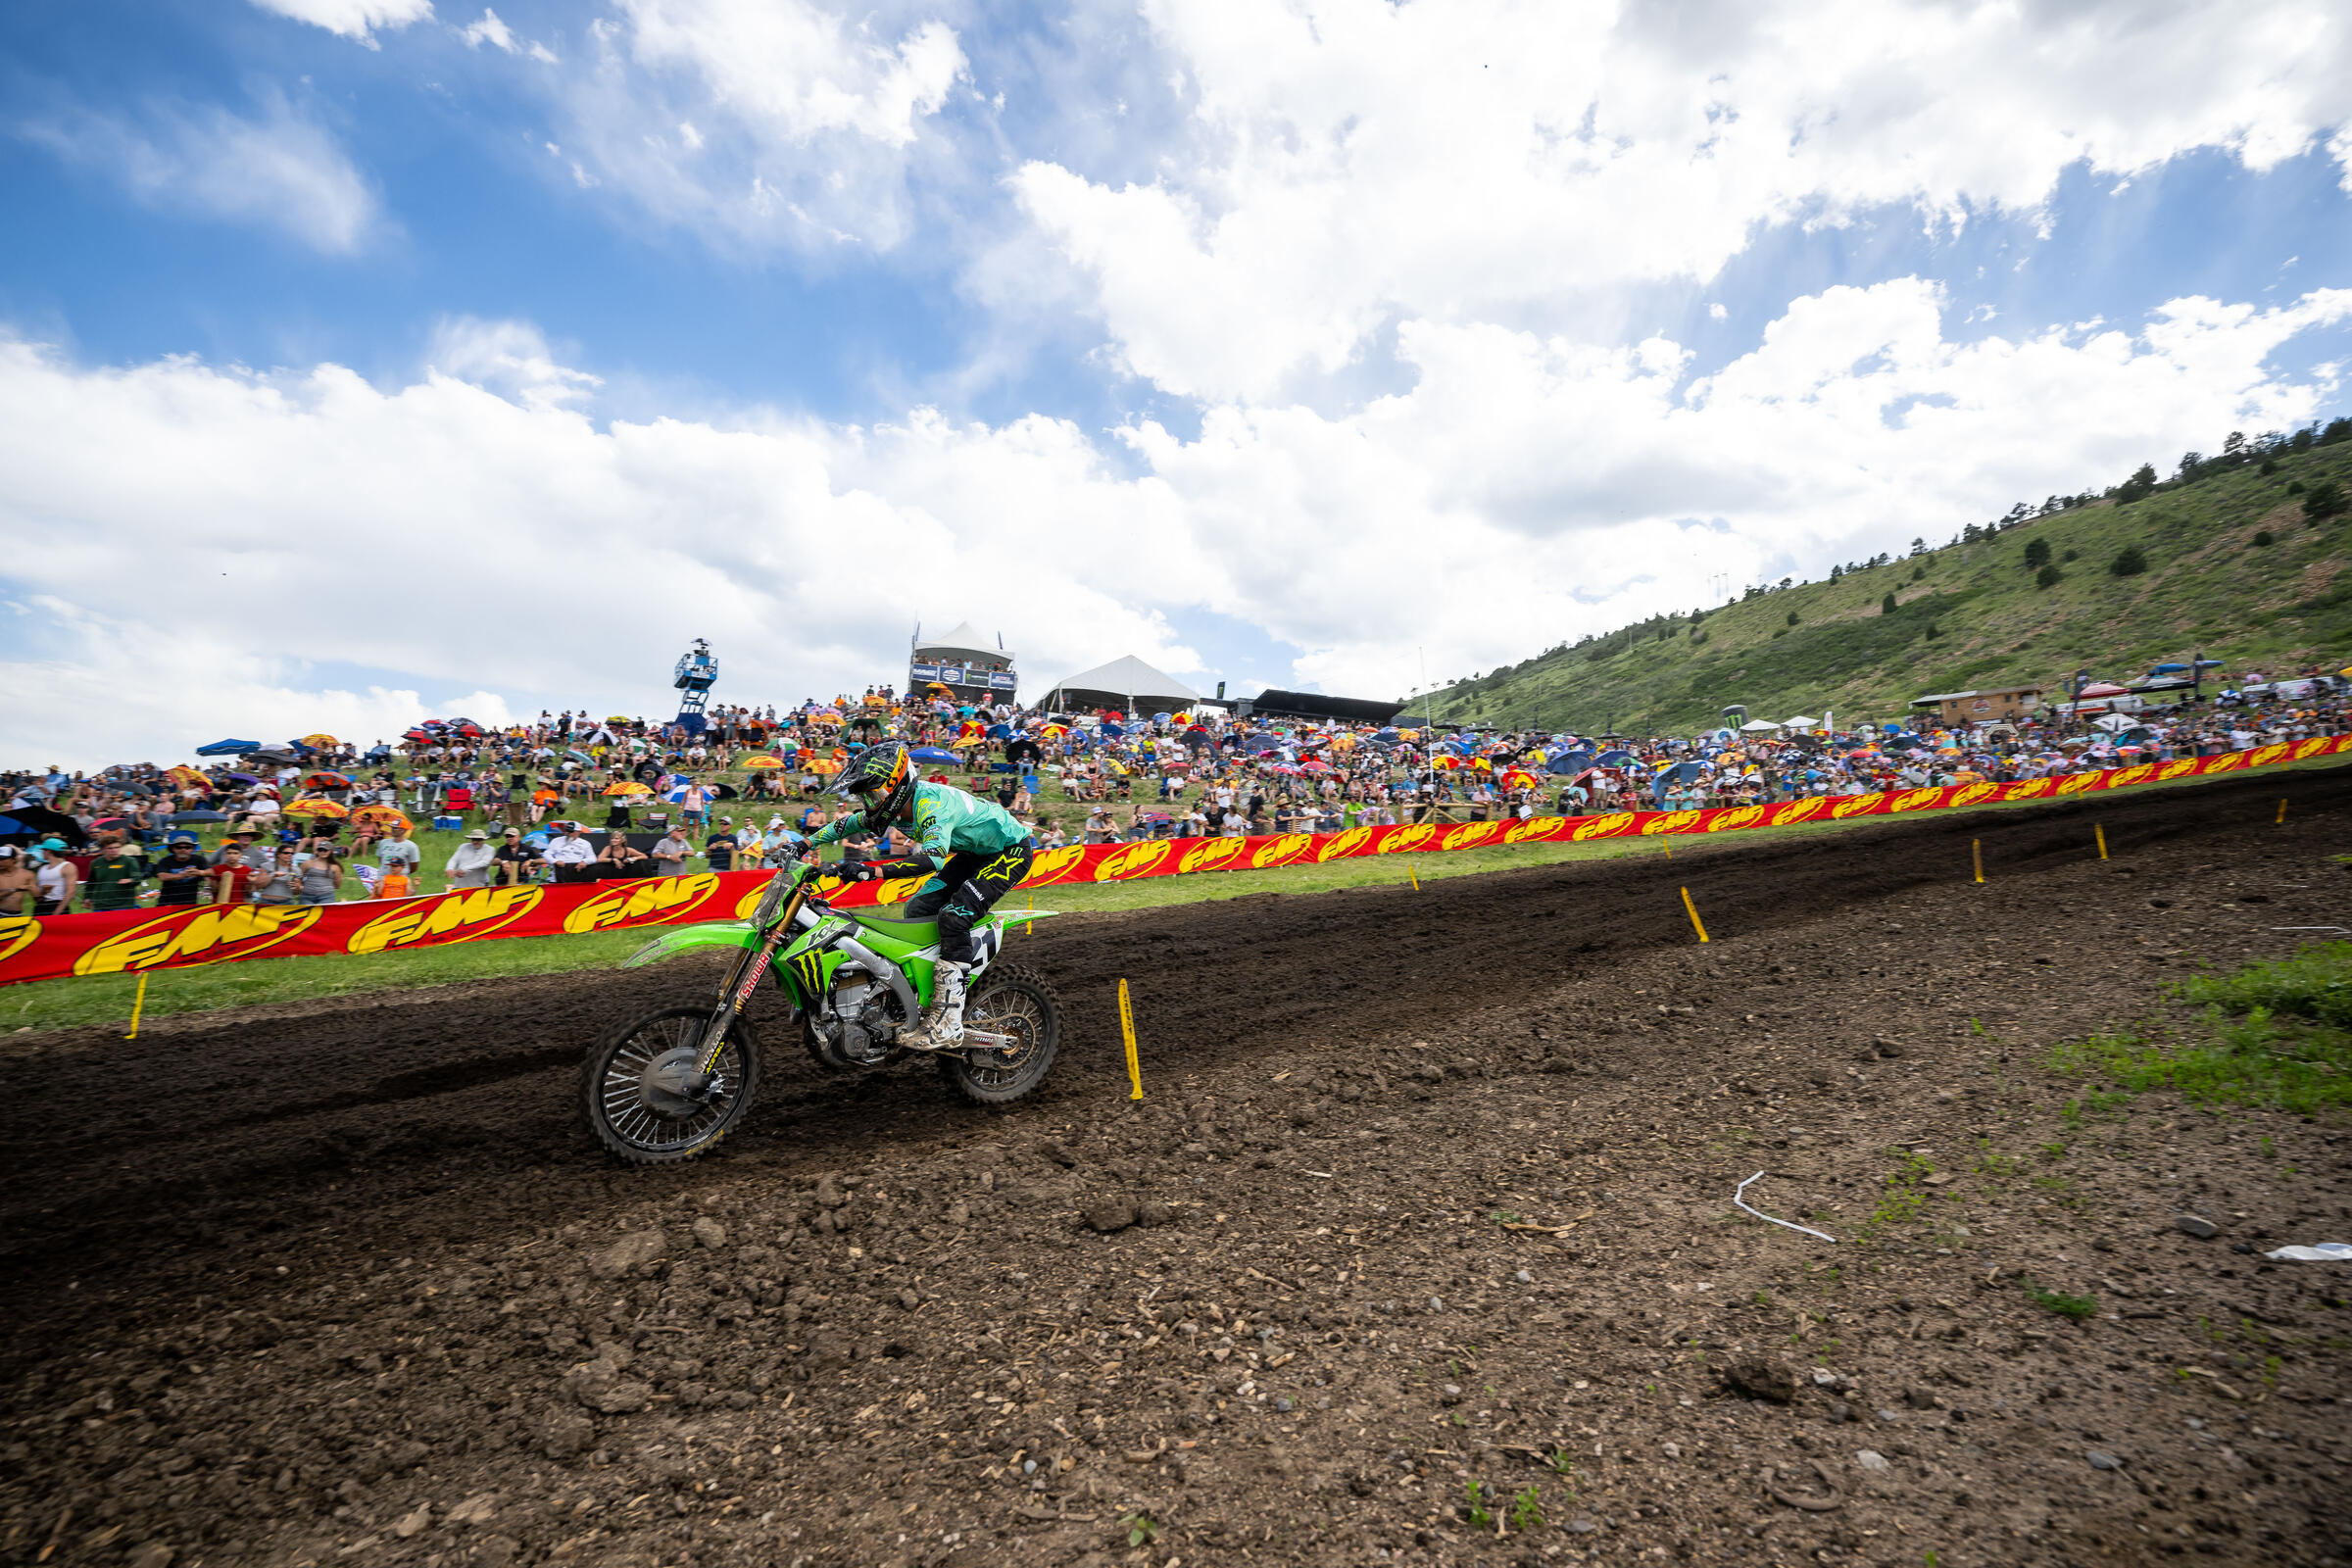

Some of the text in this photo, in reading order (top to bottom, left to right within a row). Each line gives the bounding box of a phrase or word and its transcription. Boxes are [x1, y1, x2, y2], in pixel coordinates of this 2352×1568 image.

[1574, 811, 1634, 841] FMF
[1642, 809, 1700, 834] FMF
[1708, 805, 1763, 832] FMF
[1772, 796, 1825, 825] FMF
[1319, 826, 1371, 862] FMF
[1379, 823, 1436, 854] FMF
[1444, 821, 1498, 851] FMF
[1505, 816, 1564, 844] FMF
[1027, 844, 1083, 879] MF
[1097, 839, 1170, 881] FMF
[1181, 836, 1246, 872] FMF
[1253, 834, 1311, 868] FMF
[568, 872, 716, 933] FMF
[964, 880, 984, 902] Kawasaki
[356, 885, 539, 954] FMF
[82, 904, 314, 974] FMF
[740, 952, 770, 1000] SHOWA
[706, 1041, 725, 1075] ACERBIS
